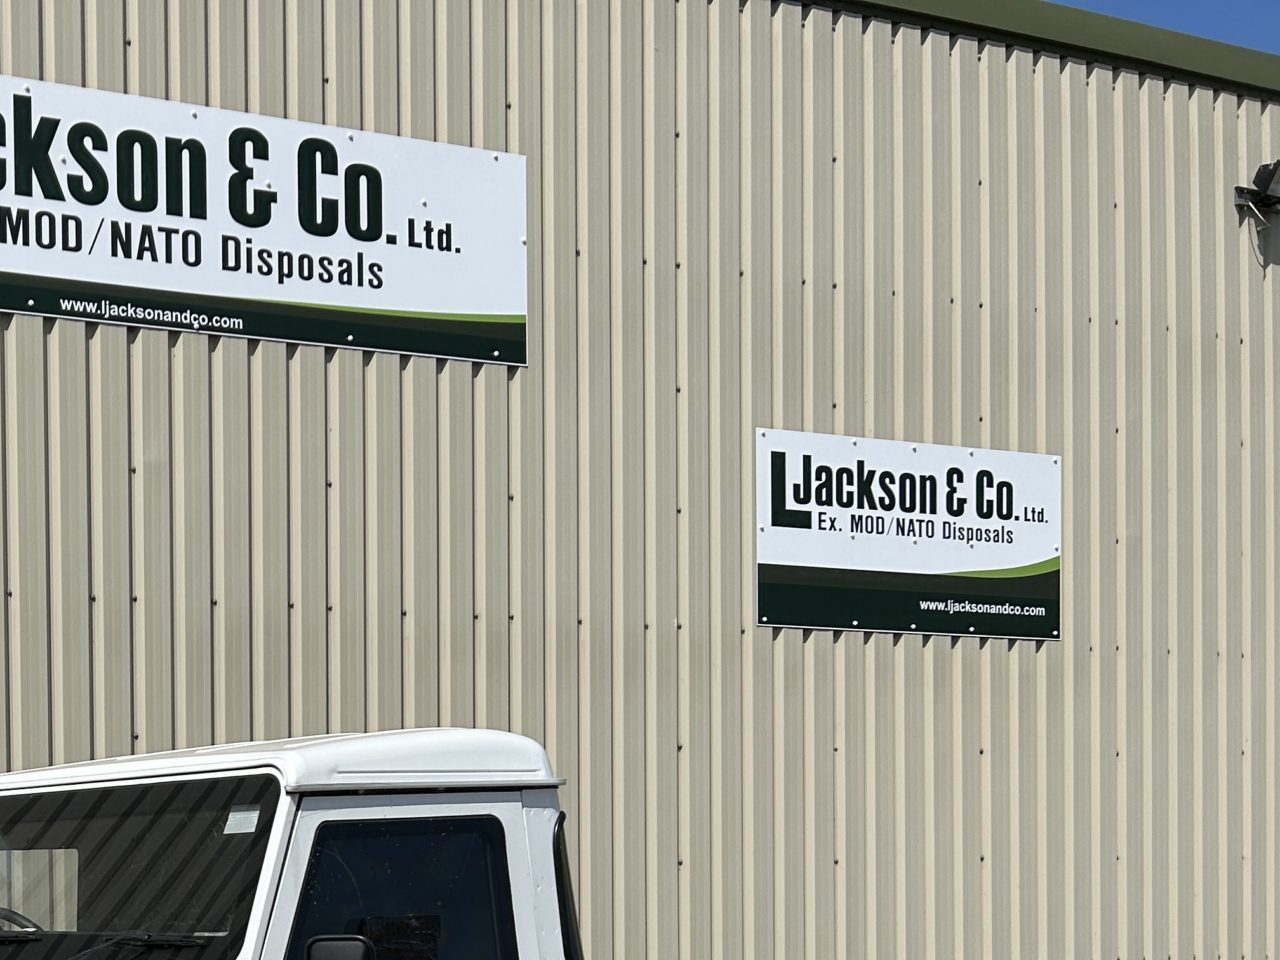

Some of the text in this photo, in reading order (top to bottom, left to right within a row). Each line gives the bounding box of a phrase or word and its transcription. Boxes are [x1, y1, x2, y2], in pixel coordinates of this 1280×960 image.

[228, 127, 278, 229] &
[297, 137, 398, 246] Co.
[407, 217, 461, 255] Ltd.
[221, 234, 385, 290] Disposals
[59, 297, 244, 331] www.ljacksonandco.com
[945, 466, 968, 518] &
[975, 469, 1020, 522] Co.
[1023, 506, 1049, 524] Ltd.
[818, 511, 1014, 545] Ex. MOD/NATO Disposals
[919, 599, 1046, 617] www.ljacksonandco.com
